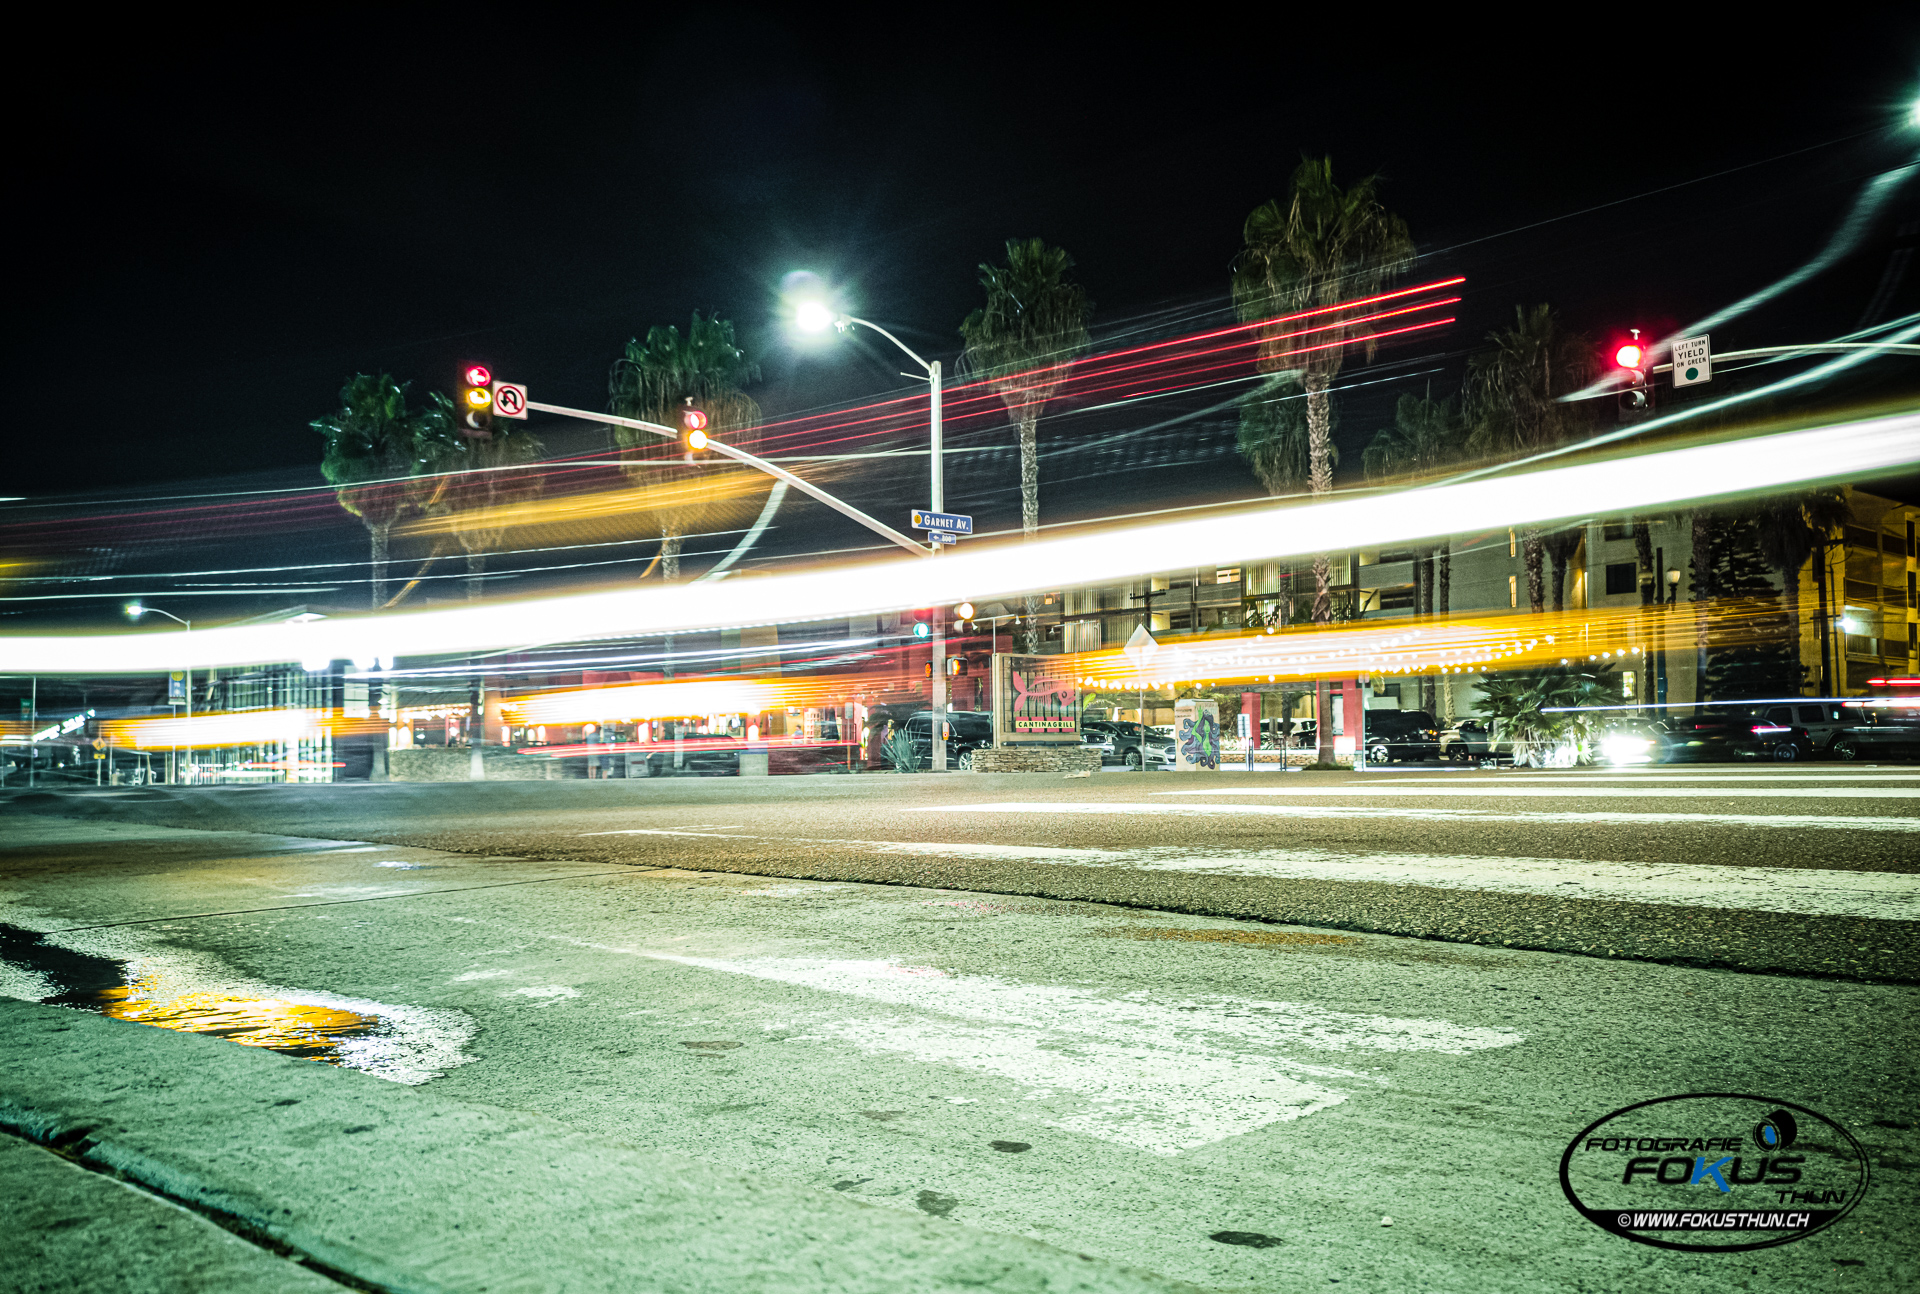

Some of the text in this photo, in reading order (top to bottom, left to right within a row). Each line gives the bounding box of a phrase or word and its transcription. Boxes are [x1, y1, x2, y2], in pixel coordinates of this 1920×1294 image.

[1675, 343, 1688, 351] LEFT
[1678, 348, 1704, 359] YIELD
[1687, 357, 1707, 366] GREEN
[924, 514, 969, 530] GARNET AV.
